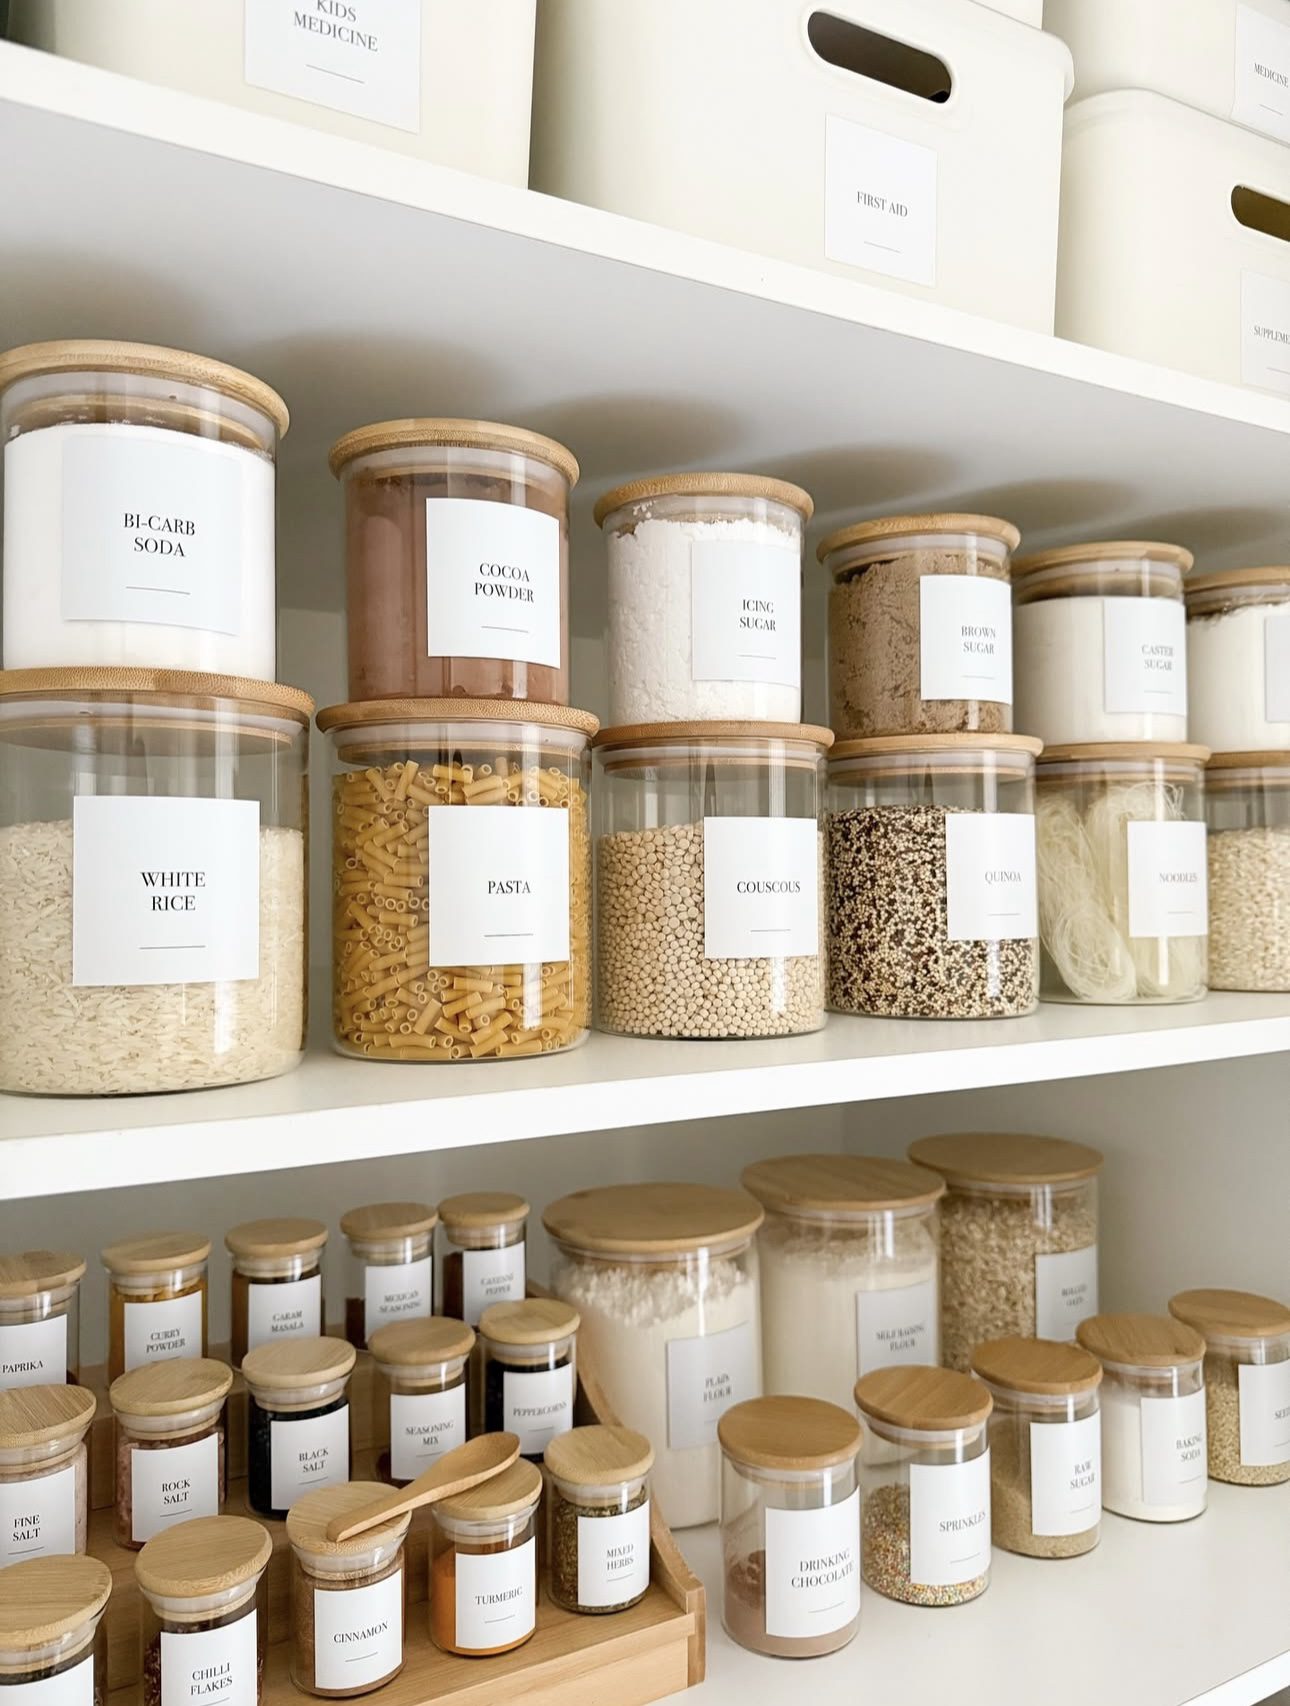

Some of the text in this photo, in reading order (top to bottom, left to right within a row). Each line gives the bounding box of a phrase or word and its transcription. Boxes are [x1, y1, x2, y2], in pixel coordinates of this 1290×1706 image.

[316, 0, 357, 22] KIDS
[293, 13, 378, 52] MEDICINE
[1254, 63, 1290, 87] MEDICINE
[857, 191, 908, 217] FIRST AID
[123, 512, 196, 537] BI-CARB
[134, 536, 186, 557] SODA
[479, 563, 530, 582] COCOA
[474, 582, 534, 603] POWDER
[742, 599, 774, 614] ICING
[739, 616, 776, 632] SUGAR
[960, 626, 996, 639] BROWN
[962, 642, 995, 655] SUGAR
[1144, 659, 1172, 671] SUGAR
[141, 871, 206, 888] WHITE
[985, 871, 1021, 884] QUINOA
[1159, 872, 1198, 884] NOODLES
[488, 880, 531, 895] PASTA
[736, 881, 800, 894] COUSCOUS
[151, 896, 196, 912] RICE
[272, 1310, 302, 1324] GARAM
[271, 1319, 304, 1333] MASALA
[150, 1328, 180, 1343] CURRY
[146, 1338, 185, 1354] POWDER
[1, 1359, 44, 1374] PAPRIKA
[406, 1420, 454, 1436] SEASONING
[422, 1436, 438, 1445] MIX
[1176, 1434, 1202, 1450] BAKING
[298, 1447, 329, 1461] BLACK
[1181, 1449, 1201, 1462] SODA
[302, 1460, 326, 1473] SALT
[1074, 1460, 1092, 1475] RAW
[161, 1479, 190, 1493] ROCK
[1070, 1473, 1095, 1489] SUGAR
[164, 1491, 189, 1505] SALT
[14, 1514, 40, 1529] FINE
[940, 1511, 986, 1533] SPRINKLES
[12, 1526, 40, 1542] SALT
[606, 1543, 634, 1558] MIXED
[607, 1556, 633, 1570] HERBS
[799, 1550, 851, 1572] DRINKING
[791, 1562, 855, 1587] CHOCOLATE
[475, 1588, 523, 1606] TURMERIC
[333, 1622, 389, 1643] CINNAMON
[191, 1663, 231, 1682] CHILLI
[190, 1675, 233, 1695] FLAKES
